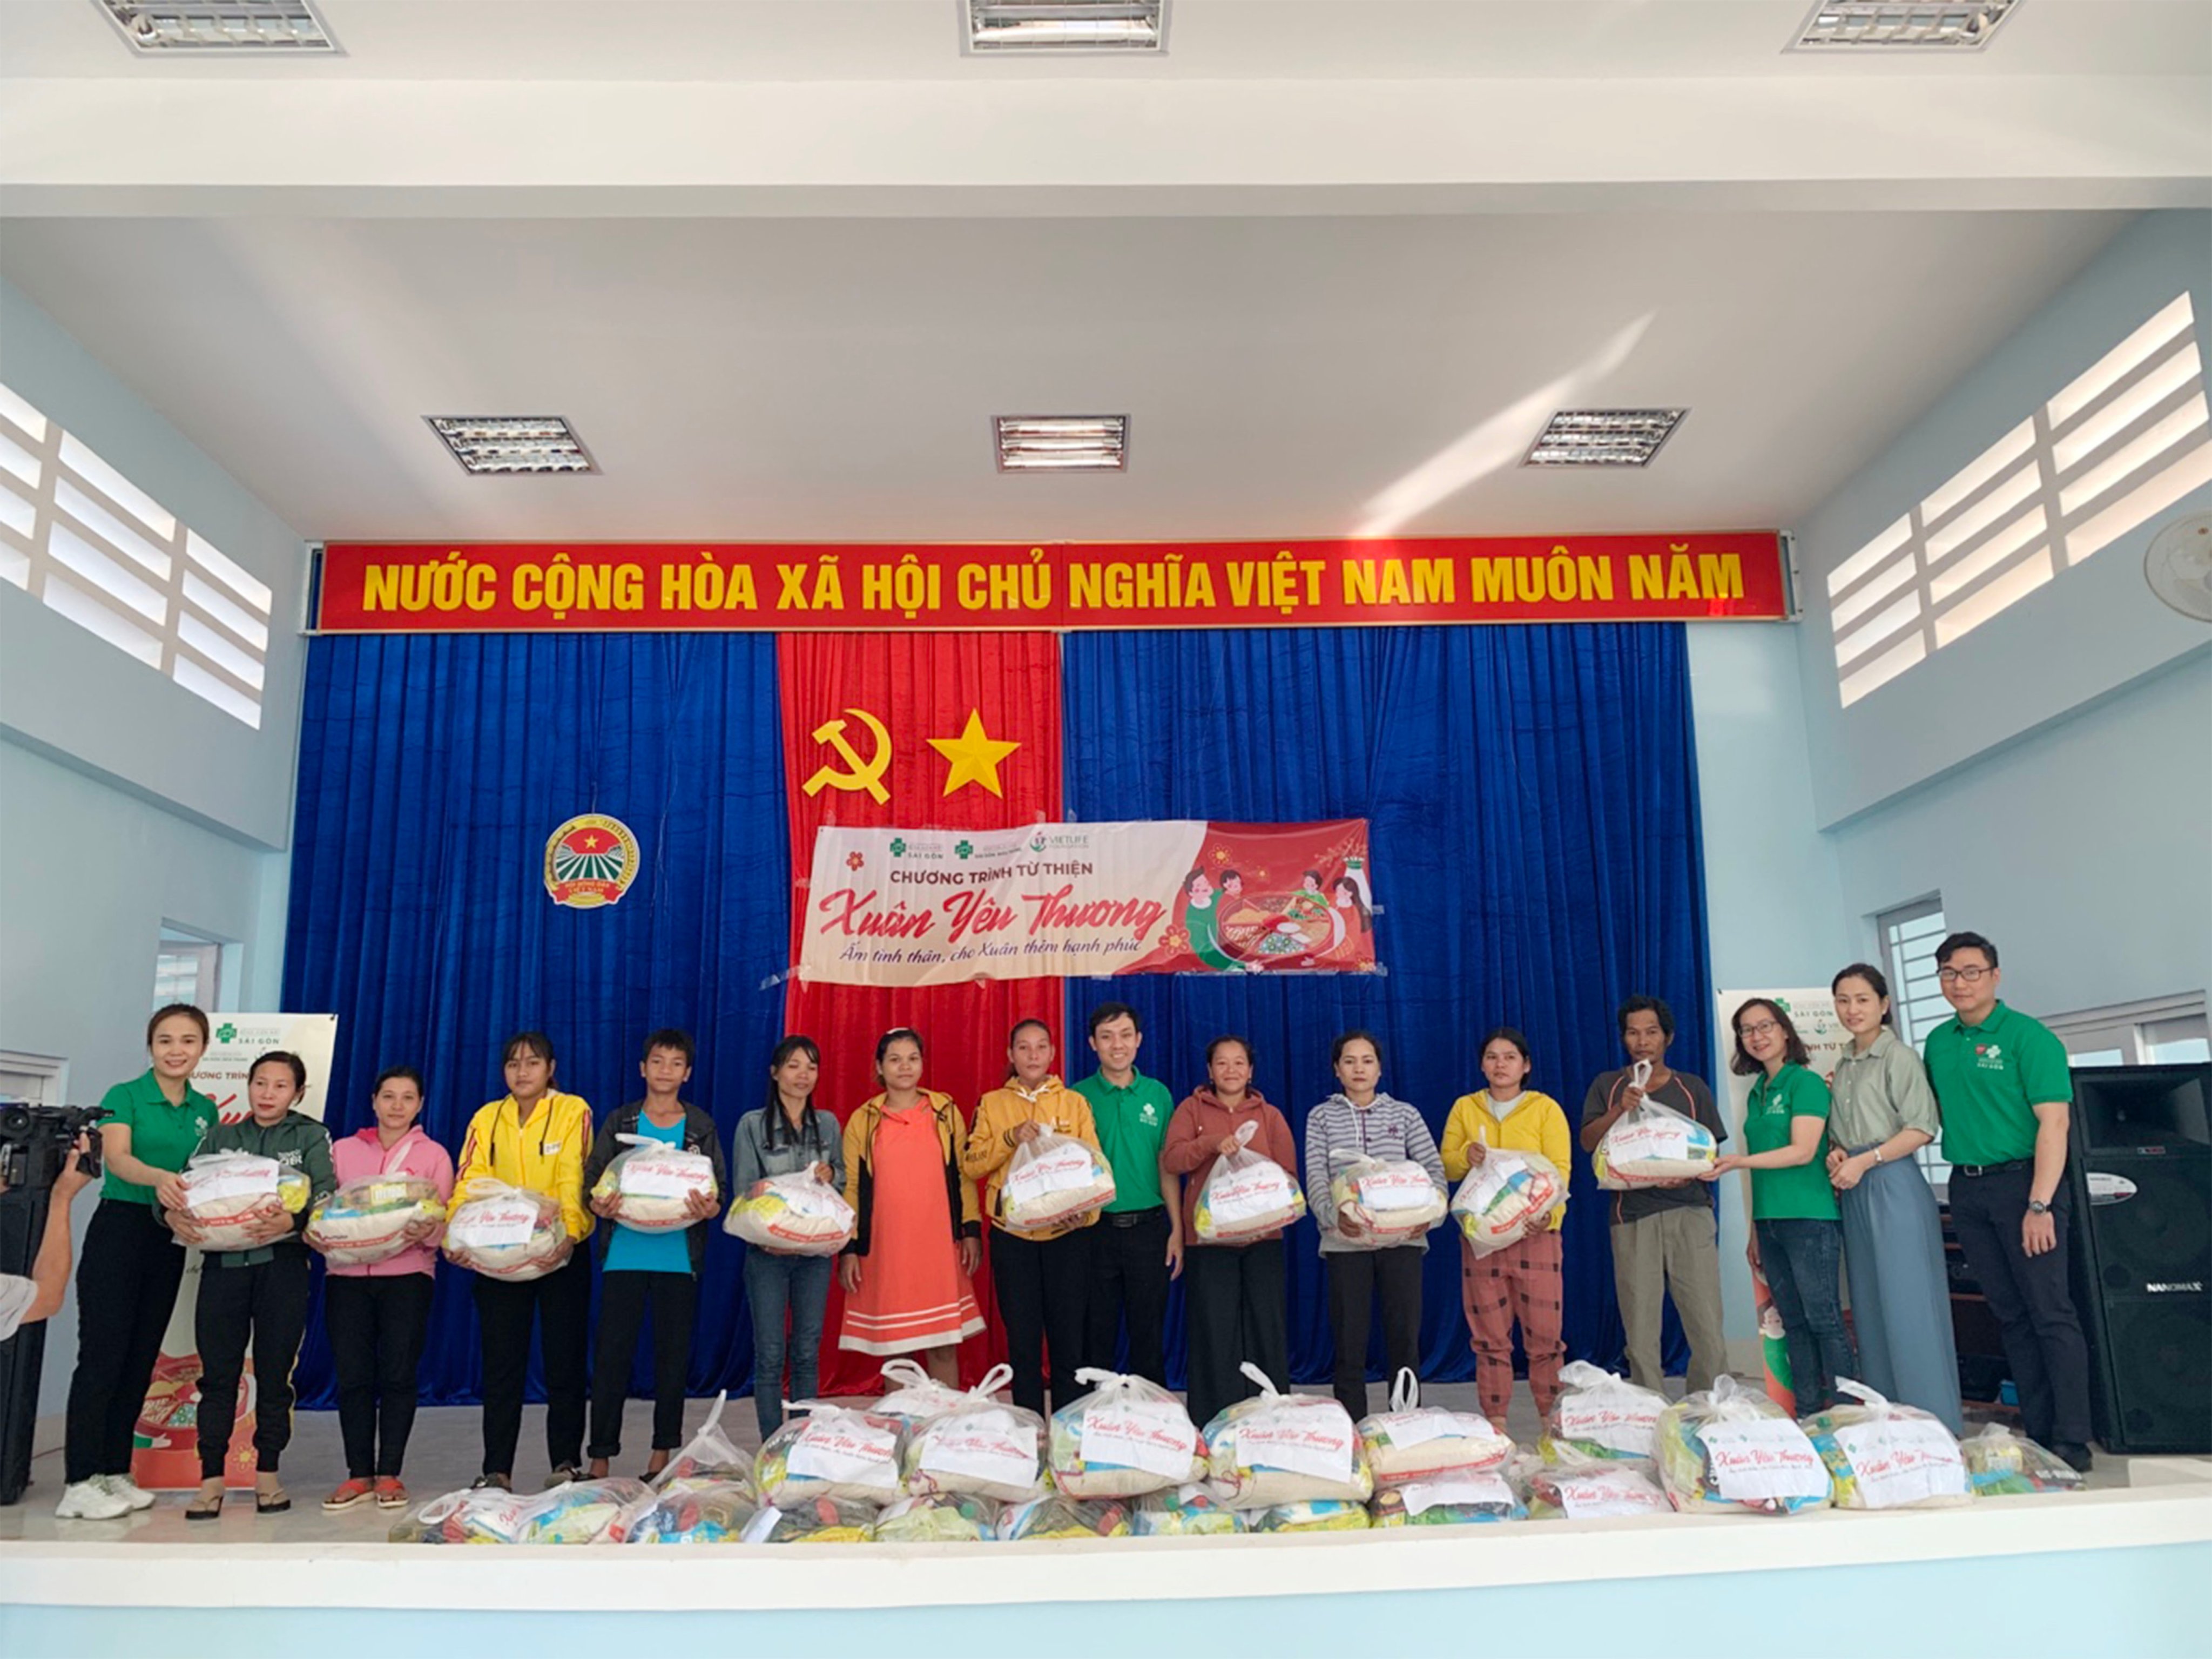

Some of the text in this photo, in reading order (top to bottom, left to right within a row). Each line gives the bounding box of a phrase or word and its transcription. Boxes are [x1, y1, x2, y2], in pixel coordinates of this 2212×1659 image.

[363, 544, 1743, 620] NƯỚC CỘNG HÒA XÃ HỘI CHỦ NGHĨA VIỆT NAM MUÔN NĂM
[890, 860, 1093, 885] CHƯƠNG TRÌNH TỪ THIỆN
[818, 883, 1167, 943] Xuân Yêu Thương
[872, 948, 902, 963] tình
[906, 949, 946, 964] thân,
[977, 942, 1019, 957] Xuân
[1023, 939, 1059, 955] thêm
[1062, 937, 1101, 956] hạnh
[1102, 937, 1142, 956] phúc
[187, 1070, 249, 1080] ƯƠNG TRÌN
